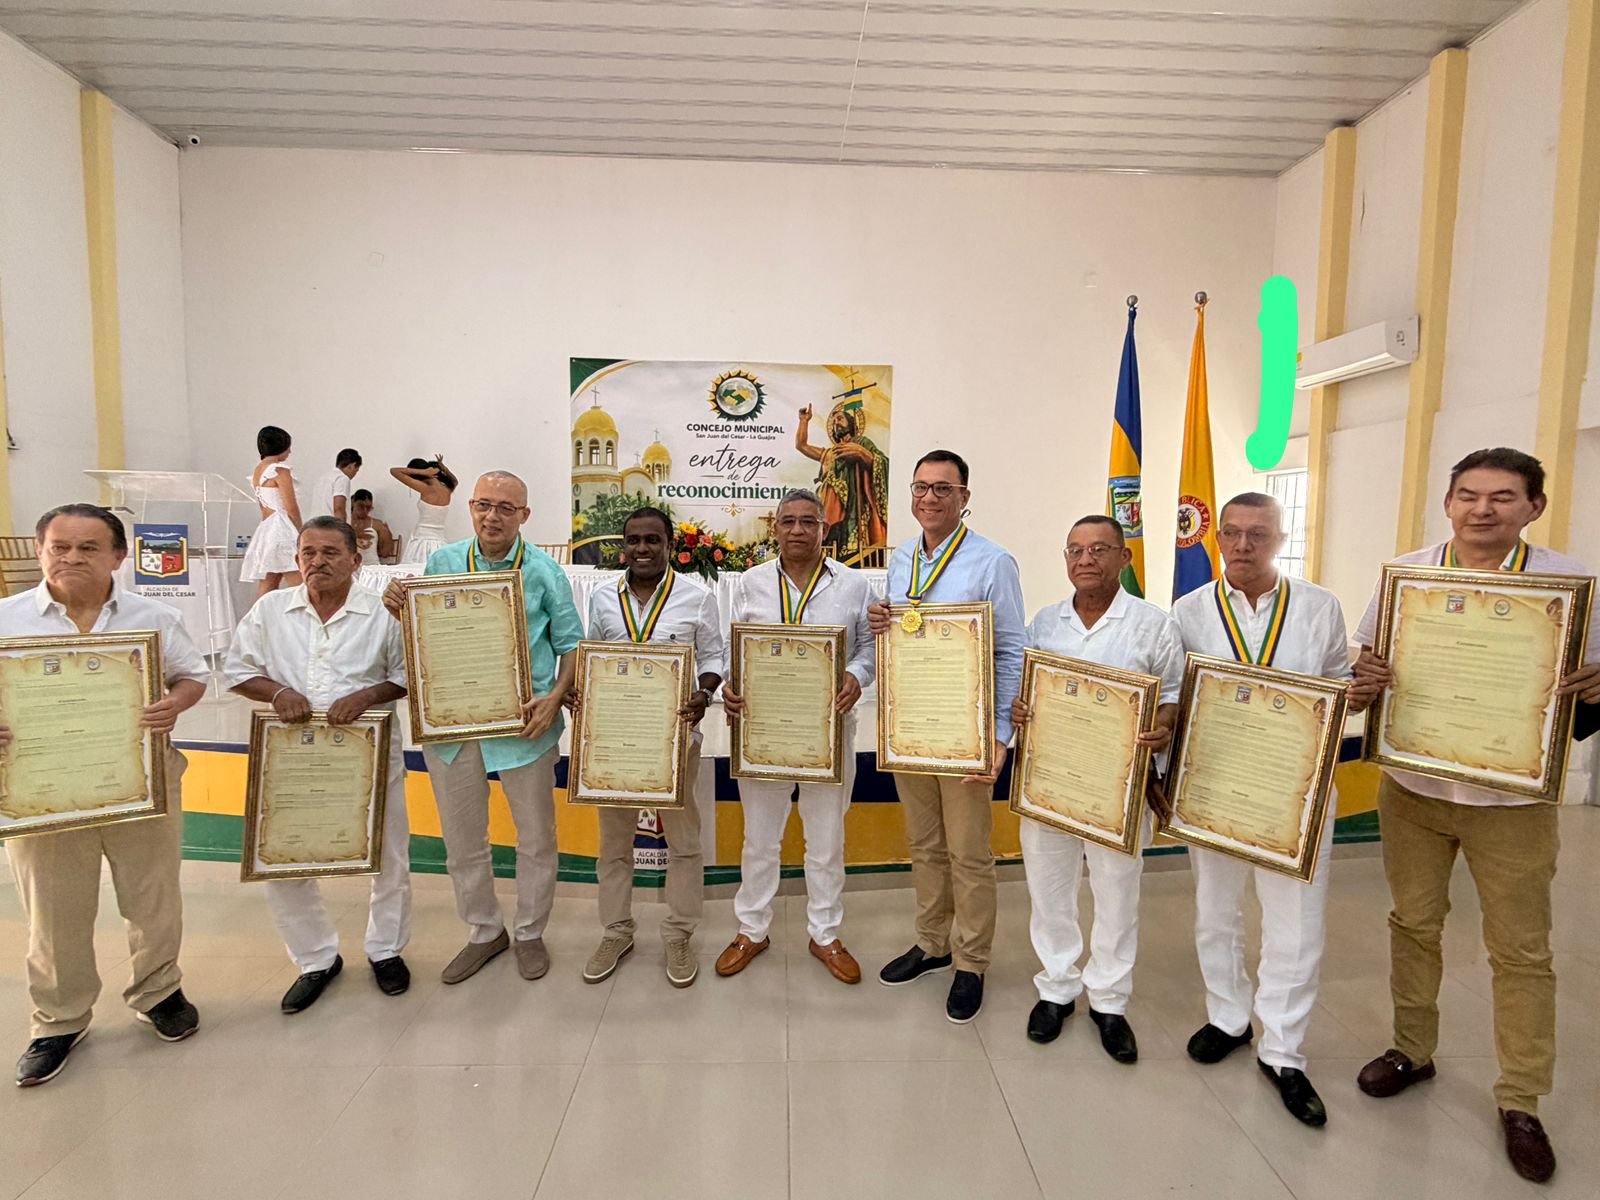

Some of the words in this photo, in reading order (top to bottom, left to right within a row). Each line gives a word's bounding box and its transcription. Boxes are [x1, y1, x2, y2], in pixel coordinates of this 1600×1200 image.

[686, 423, 732, 432] CONCEJO
[734, 425, 785, 434] MUNICIPAL
[689, 443, 782, 482] entrega
[727, 469, 741, 481] de
[657, 482, 802, 499] reconocimient
